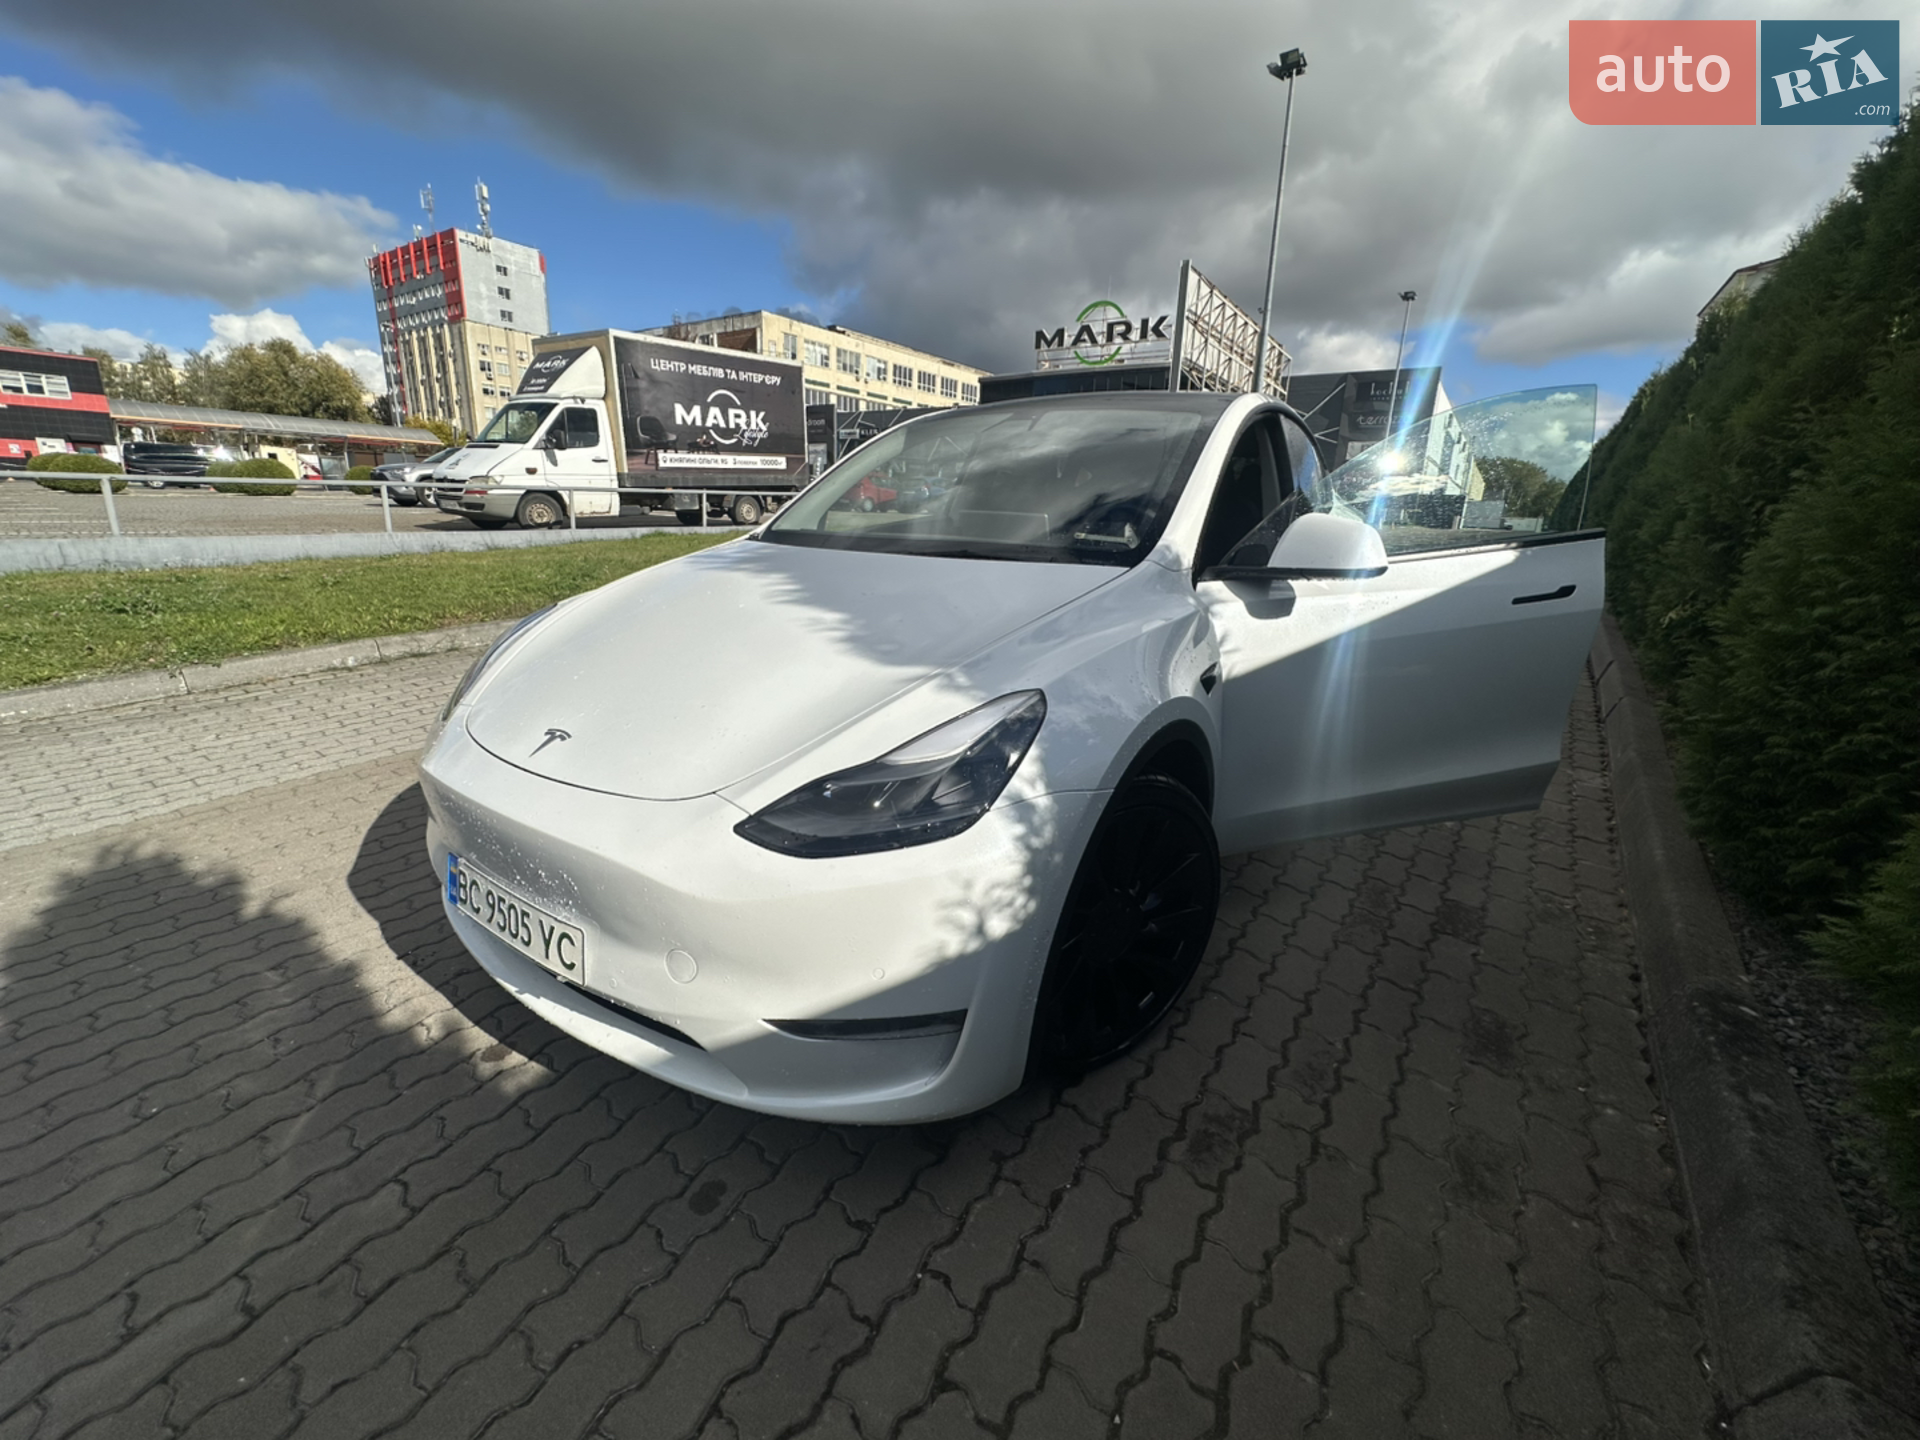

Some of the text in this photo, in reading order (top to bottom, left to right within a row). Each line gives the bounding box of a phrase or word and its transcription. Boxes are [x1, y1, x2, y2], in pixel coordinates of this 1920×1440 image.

[1035, 314, 1171, 350] MARK
[650, 358, 686, 373] ЦЕНТР
[688, 363, 725, 378] МЕБЛІВ
[725, 368, 738, 380] ТА
[674, 402, 768, 431] MARK
[459, 868, 577, 971] BC 9505 YC
